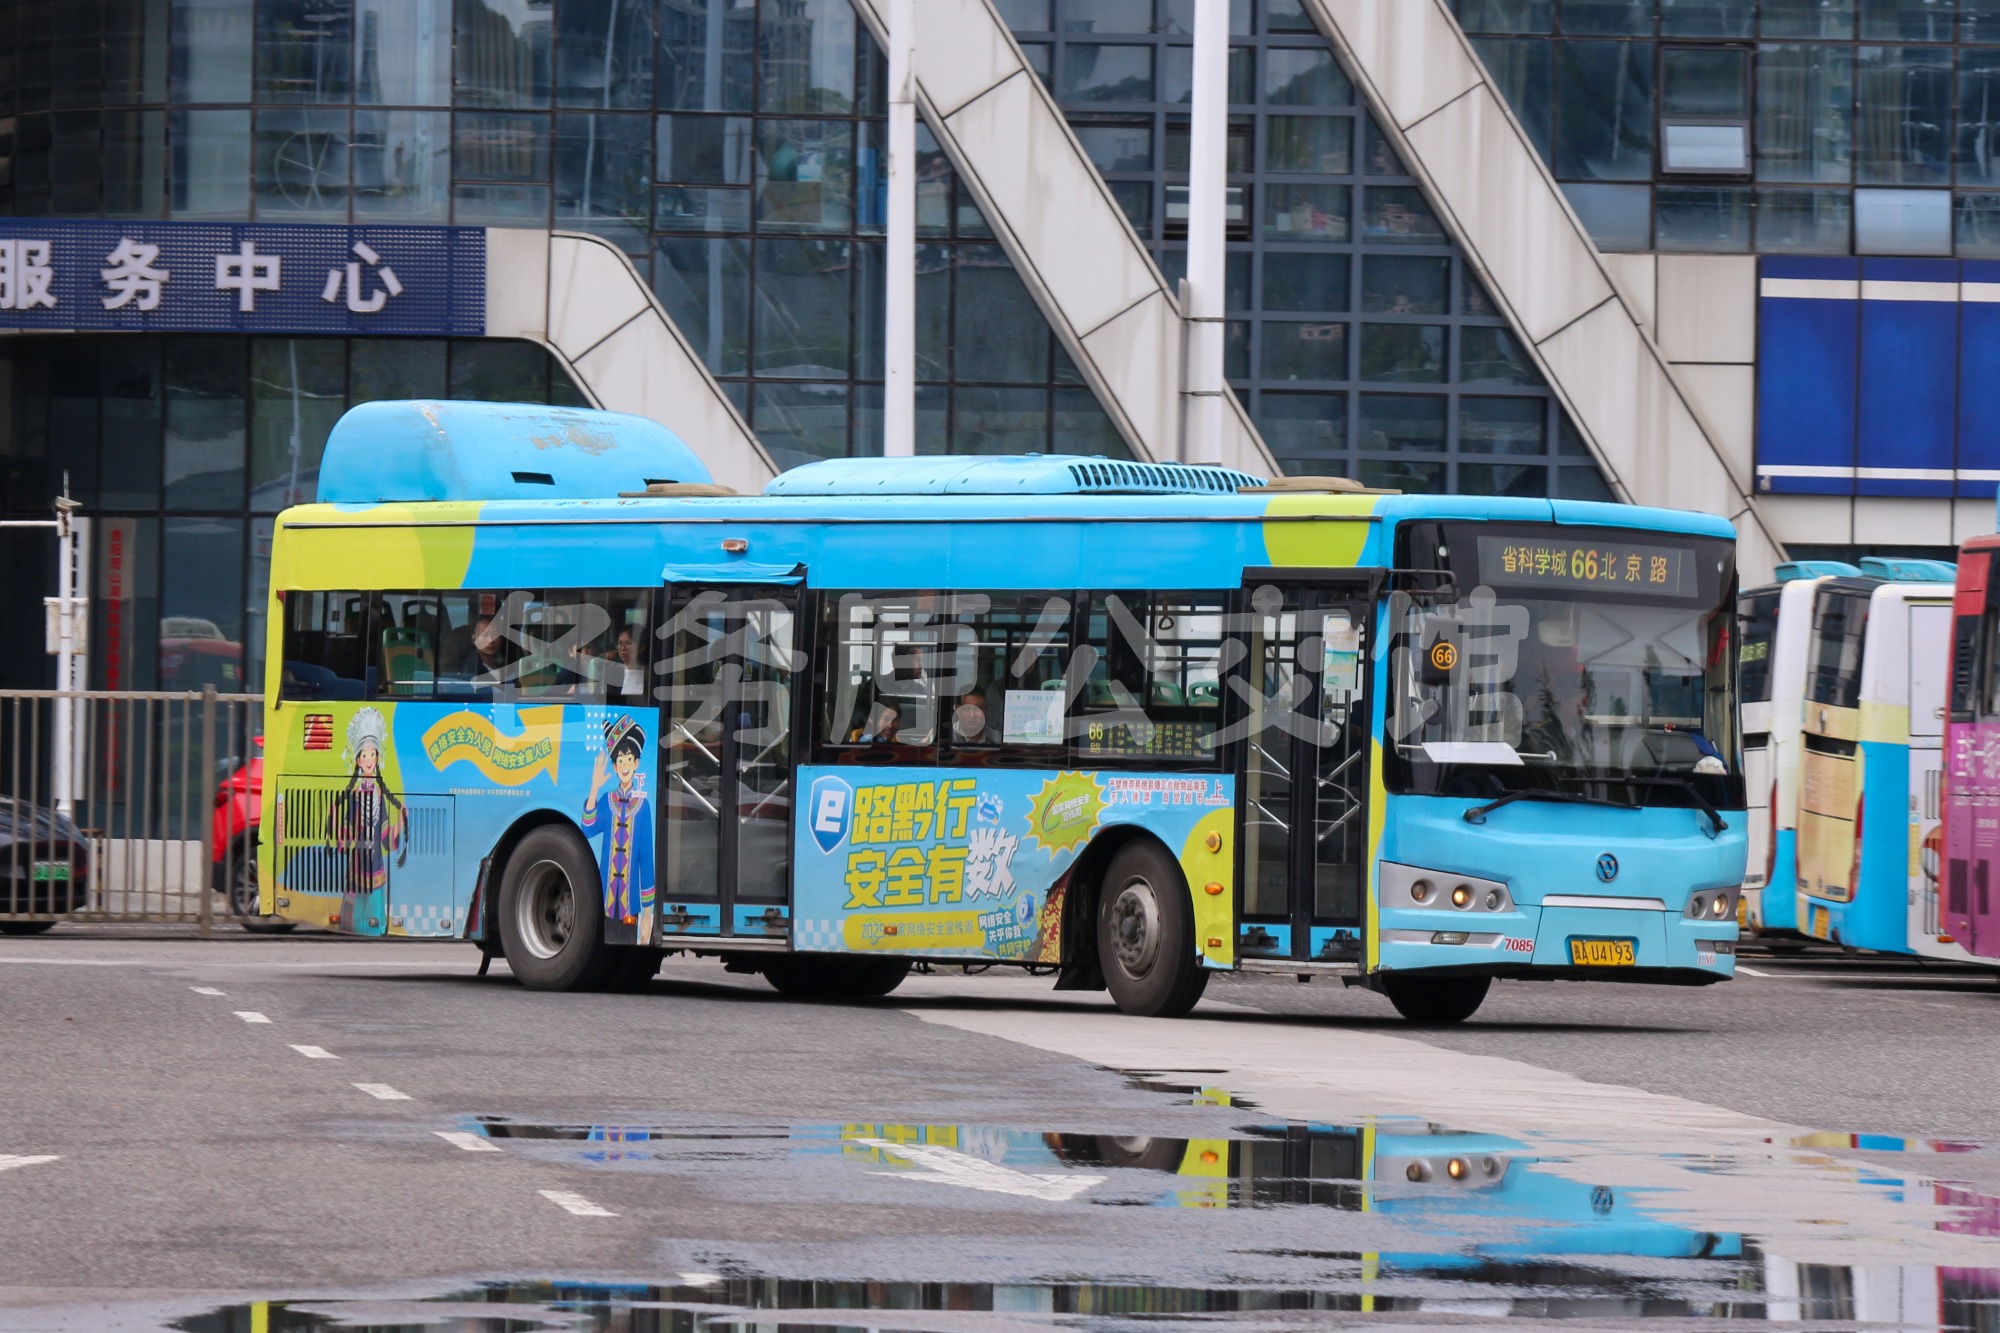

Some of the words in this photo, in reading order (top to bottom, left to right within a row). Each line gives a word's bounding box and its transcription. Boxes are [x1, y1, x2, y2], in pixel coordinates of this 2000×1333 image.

[0, 237, 404, 313] 服务中心
[1502, 546, 1567, 576] 省科学城
[1571, 548, 1598, 580] 66
[1435, 649, 1454, 664] 66
[1088, 723, 1103, 740] 66
[429, 726, 493, 762] 网络安全为人民
[491, 737, 552, 770] 网络安全靠人民
[634, 773, 645, 791] 下
[1211, 779, 1223, 798] 上
[850, 777, 977, 845] 路黔行
[842, 827, 1019, 910] 安全有数
[978, 910, 1013, 930] 网络安全
[988, 925, 1022, 943] 关乎你我
[998, 939, 1032, 956] 共同守护
[1504, 937, 1534, 953] 7085
